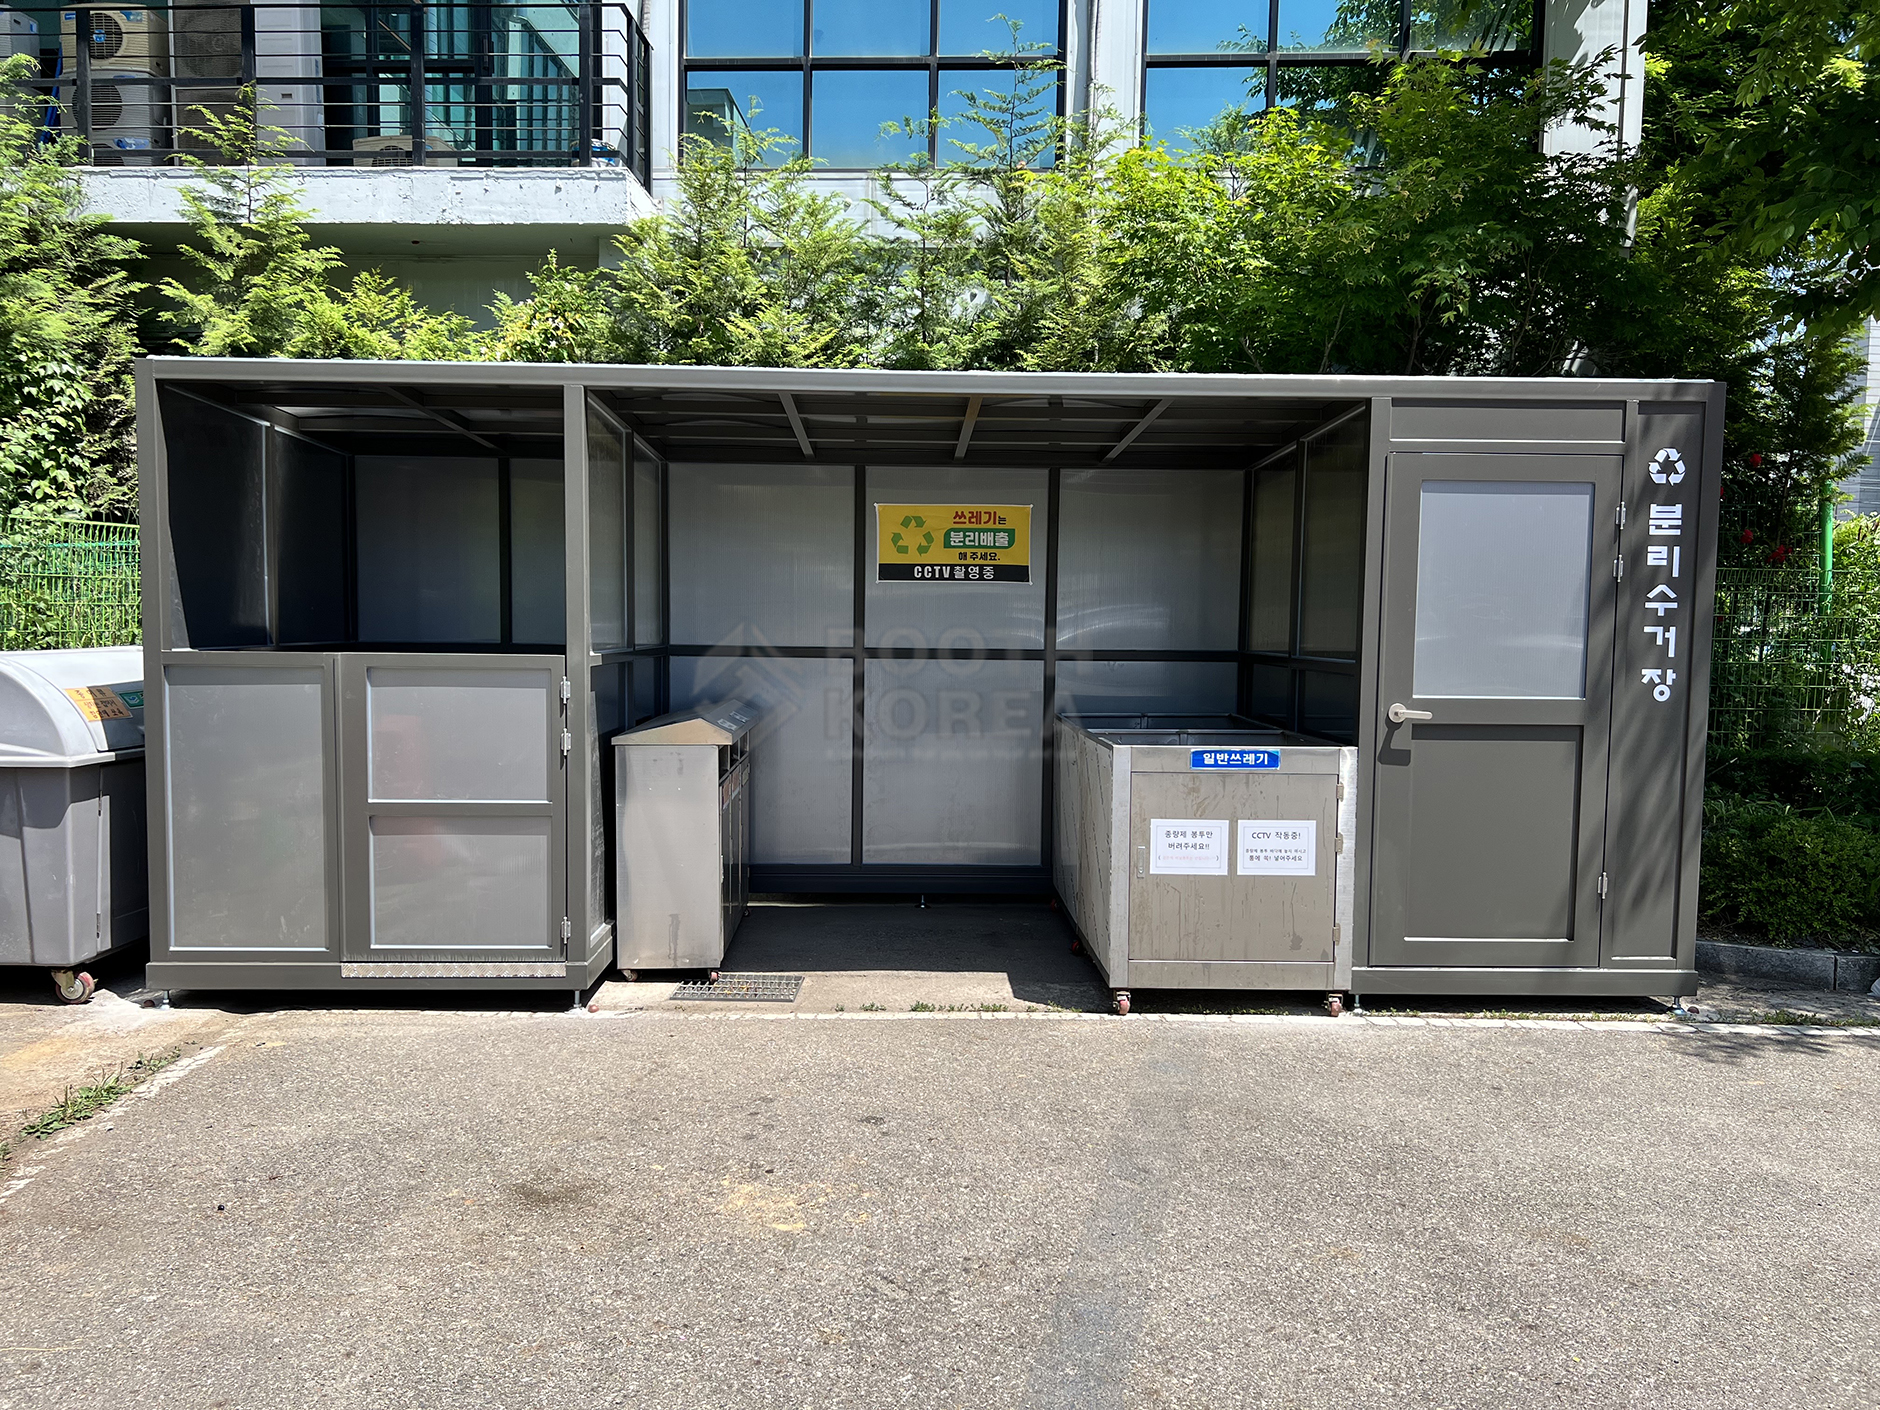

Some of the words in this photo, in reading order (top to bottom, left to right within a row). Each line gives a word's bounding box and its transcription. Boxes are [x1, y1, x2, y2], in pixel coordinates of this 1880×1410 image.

[953, 510, 1007, 525] 쓰레기는
[949, 531, 1009, 547] 분리배출
[958, 552, 967, 561] 해
[969, 552, 1001, 561] 주세요.
[1641, 503, 1683, 702] 분리수거장
[1203, 752, 1269, 765] 일반쓰레기
[1164, 830, 1187, 839] 종량제
[1251, 831, 1272, 839] CCTV
[1274, 831, 1301, 840] 작동중!
[1167, 842, 1210, 851] 버려주세요!!
